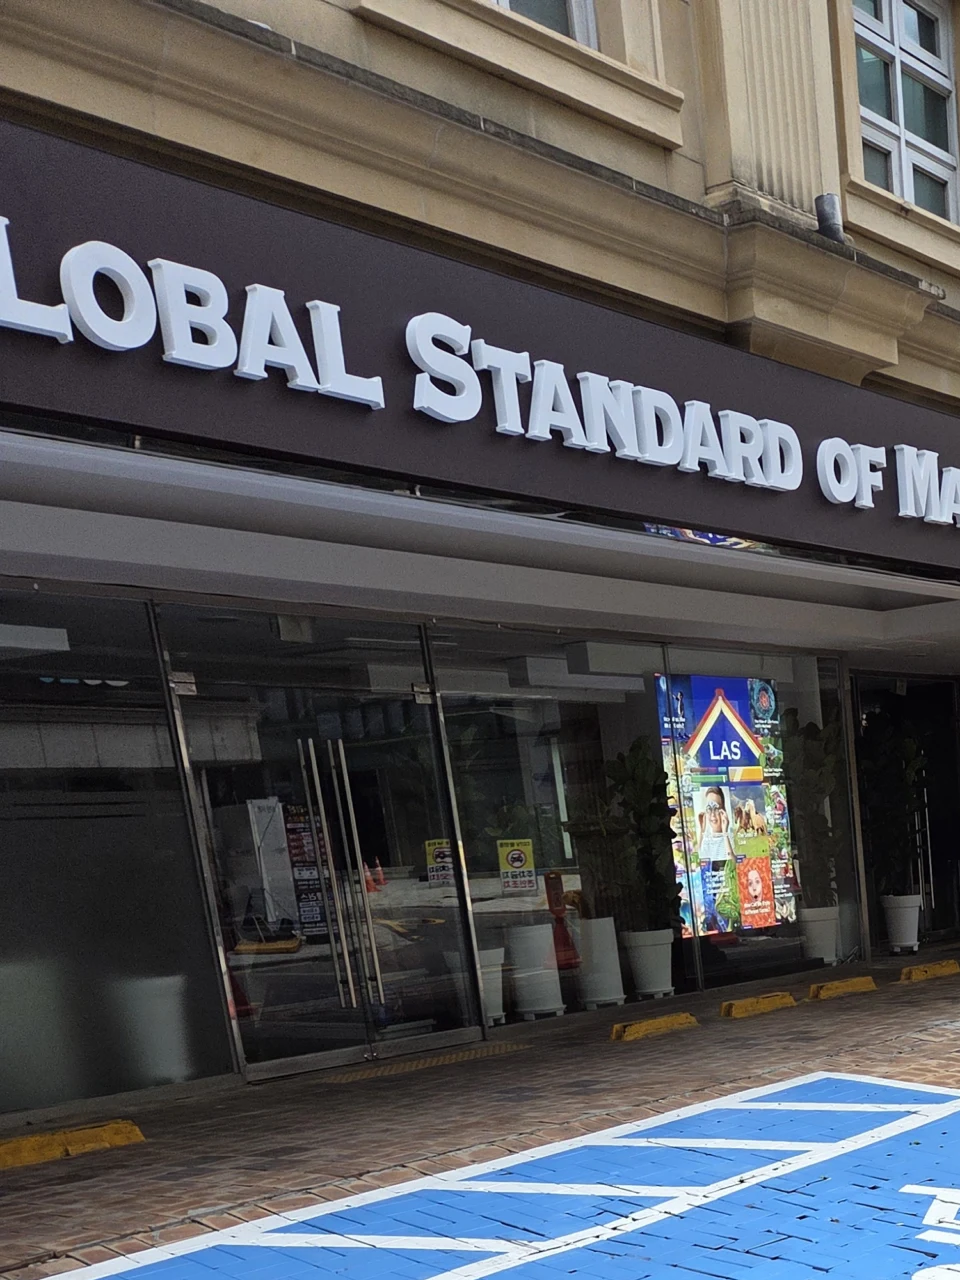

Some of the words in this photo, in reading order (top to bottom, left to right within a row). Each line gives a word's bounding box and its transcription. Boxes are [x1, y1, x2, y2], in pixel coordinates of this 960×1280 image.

[405, 312, 803, 492] STANDARD
[817, 437, 886, 509] OF
[709, 741, 741, 760] LAS
